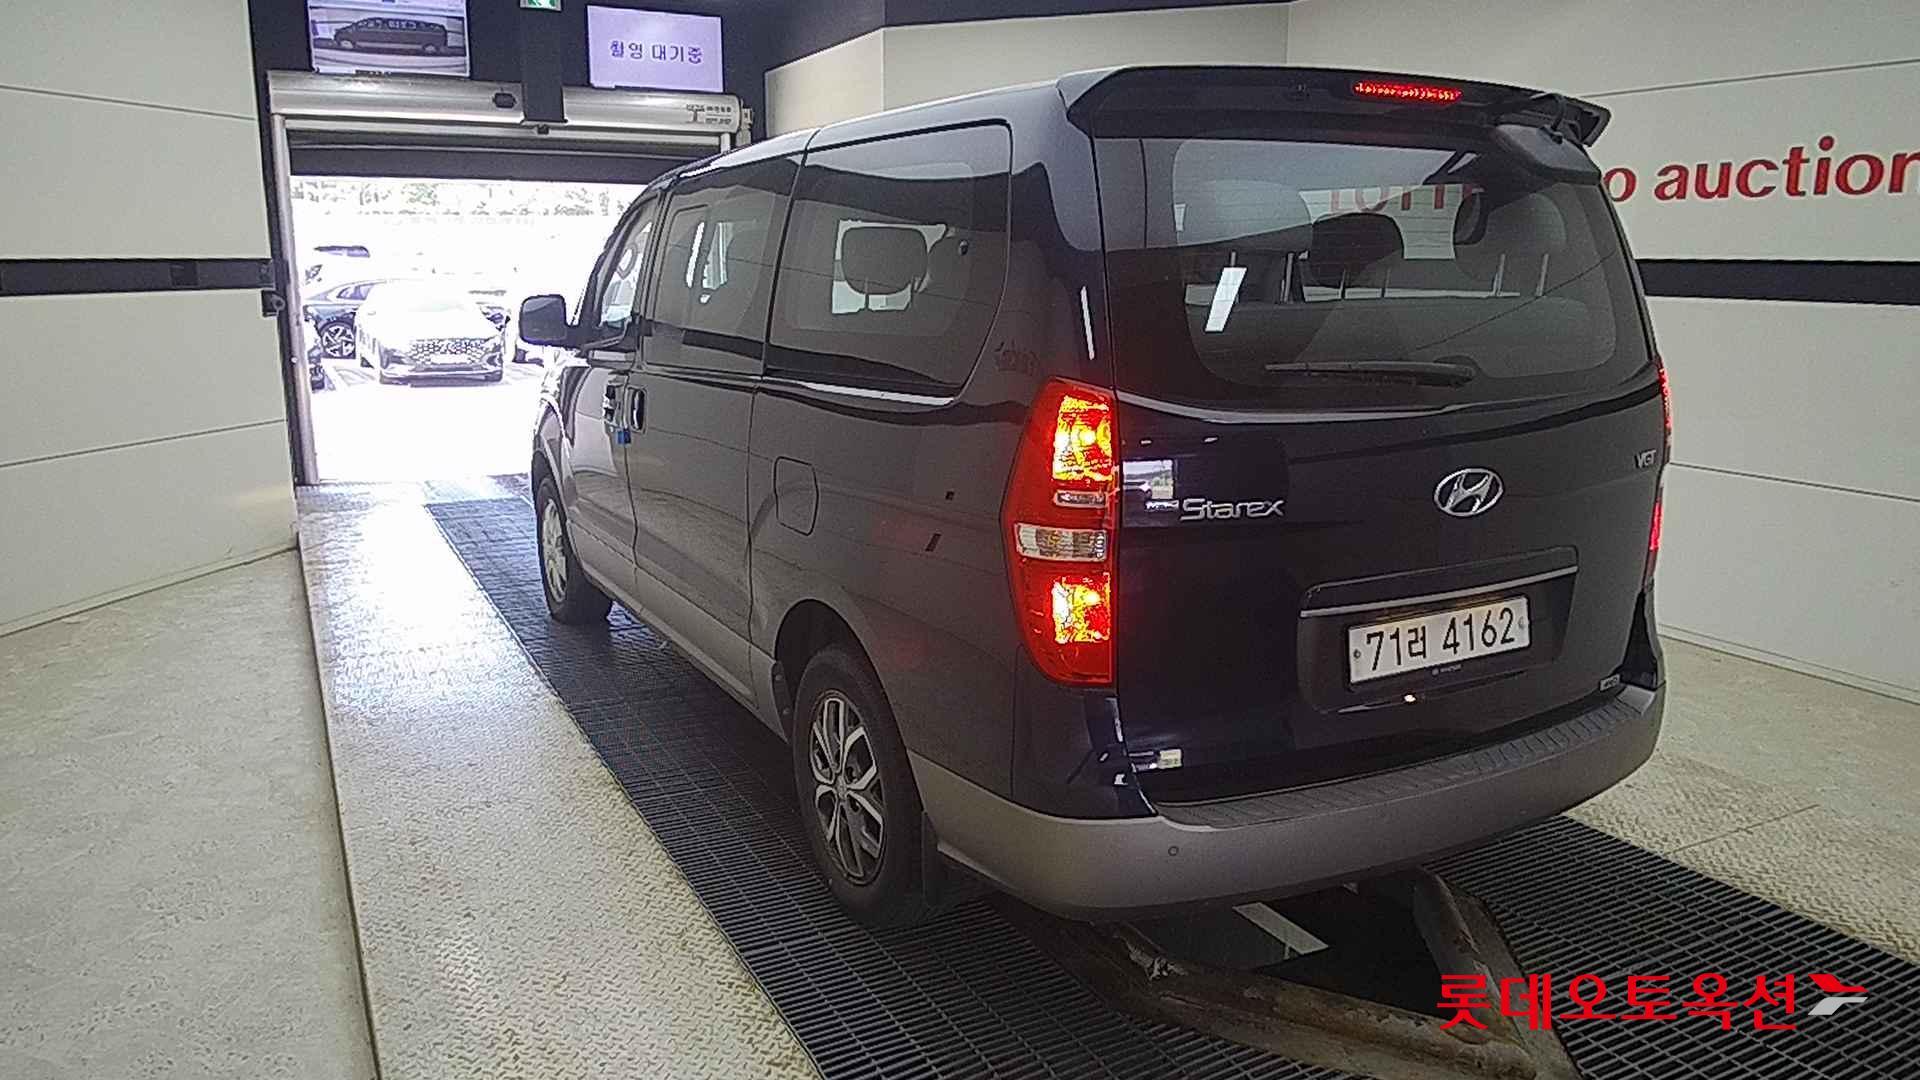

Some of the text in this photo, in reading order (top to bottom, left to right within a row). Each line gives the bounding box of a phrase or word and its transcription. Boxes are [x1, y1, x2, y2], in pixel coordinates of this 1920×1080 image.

[651, 44, 702, 64] 대기중
[1179, 497, 1285, 522] Starex
[1366, 606, 1516, 671] 71러 4162
